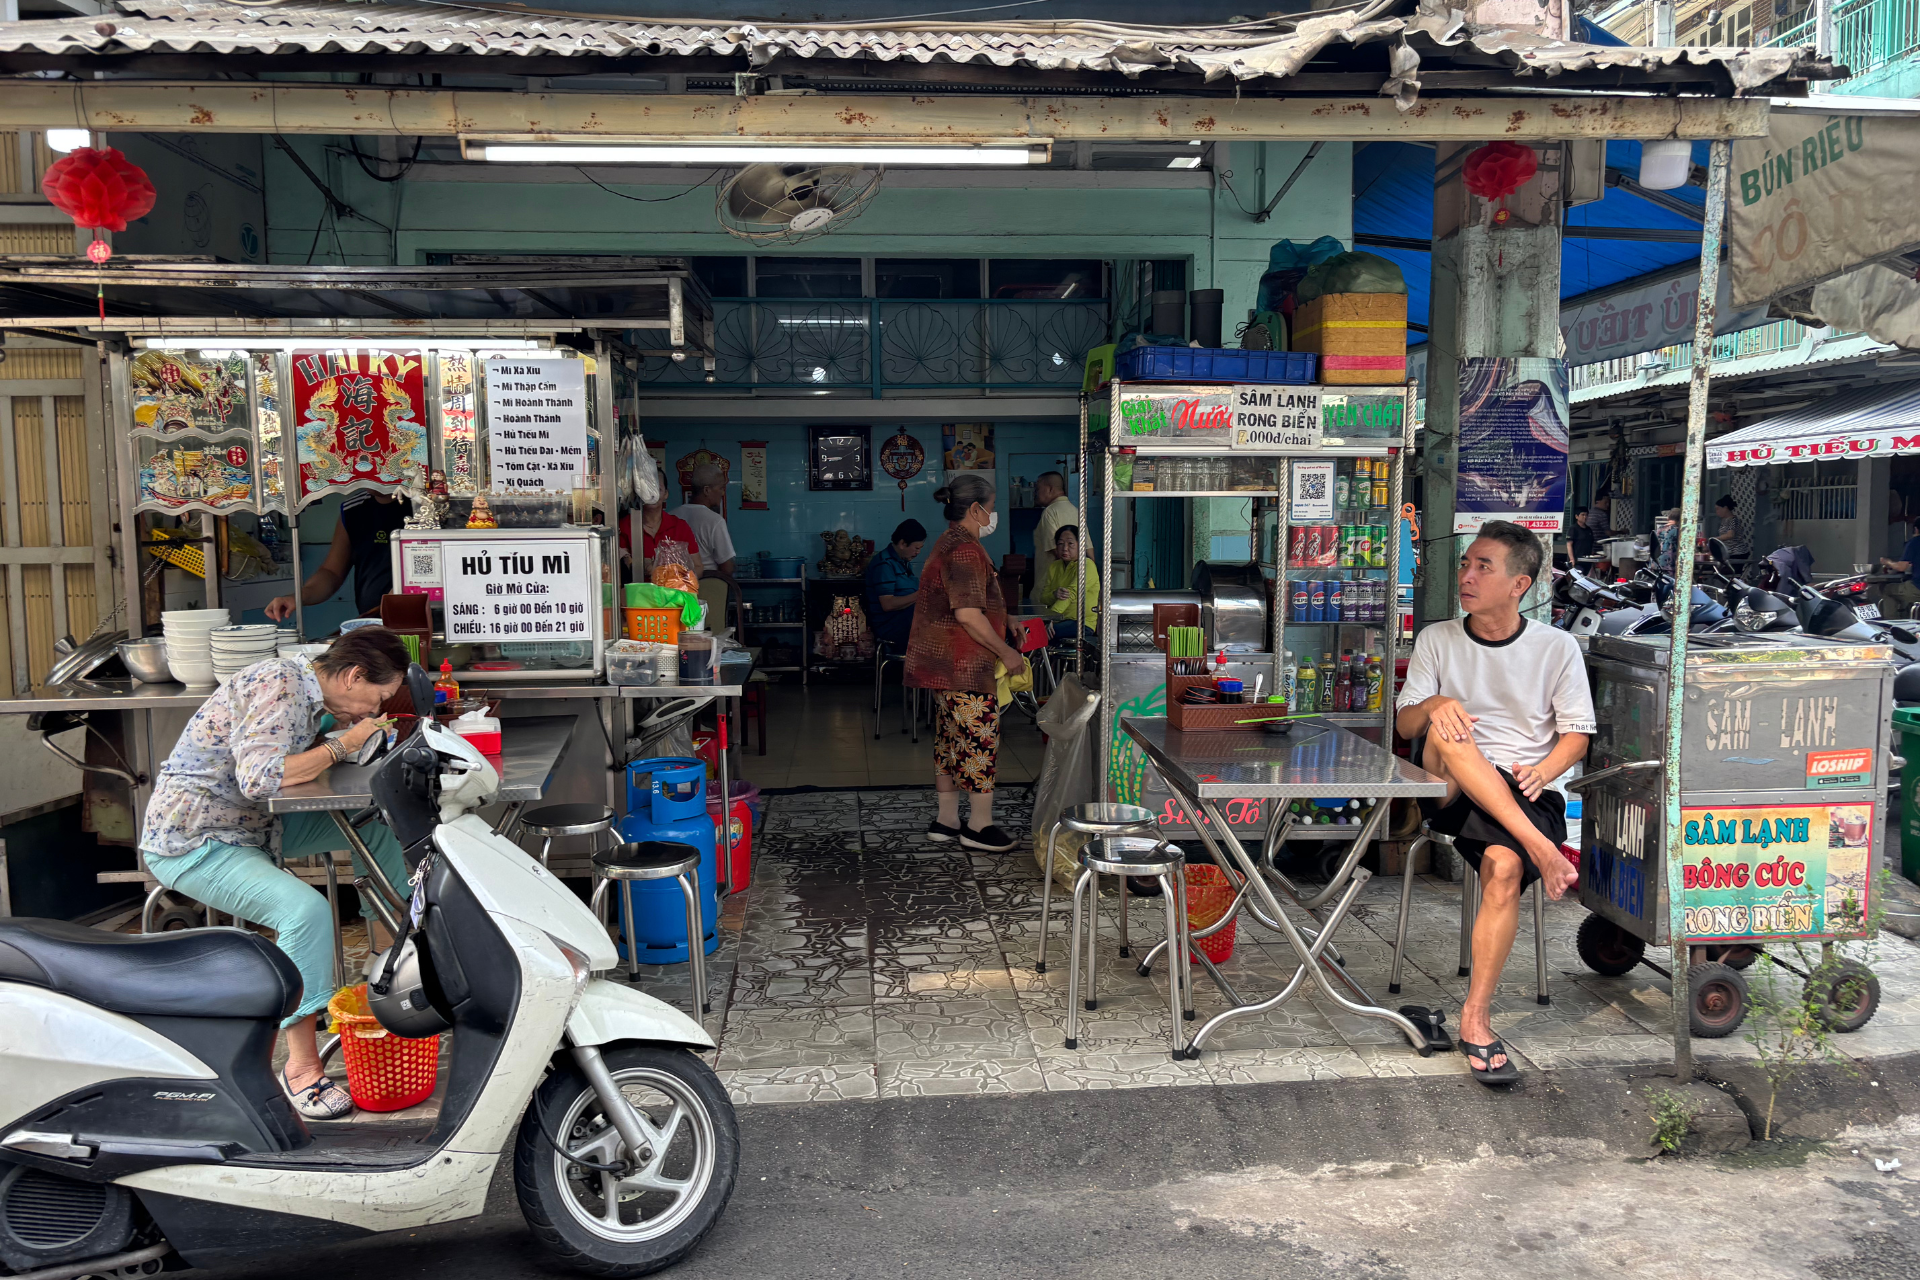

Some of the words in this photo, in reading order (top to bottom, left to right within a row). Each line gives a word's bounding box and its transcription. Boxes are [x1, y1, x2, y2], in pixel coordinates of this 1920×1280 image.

[1740, 149, 1793, 206] BÚN
[296, 348, 360, 386] HAI
[368, 348, 420, 383] KY
[1120, 395, 1152, 417] Giải
[1239, 390, 1272, 406] SÂM
[1277, 394, 1317, 410] LẠNH
[1362, 396, 1404, 428] CHẤT
[1128, 411, 1168, 436] Khát
[1237, 413, 1277, 428] RONG
[1282, 409, 1317, 429] BIỂN
[1726, 444, 1778, 462] HỦ
[1785, 436, 1881, 457] TIẾU
[462, 550, 492, 575] HỦ
[499, 552, 534, 574] TÍU
[542, 551, 570, 574] MÌ
[486, 583, 503, 594] Giờ
[506, 582, 522, 594] Mở
[526, 582, 550, 594] Cửa:
[452, 602, 478, 616] SÁNG
[494, 604, 500, 614] 6
[503, 603, 518, 616] giờ
[520, 603, 532, 614] 00
[534, 601, 552, 614] Đến
[555, 602, 566, 614] 10
[569, 602, 584, 615] giờ
[490, 622, 500, 634] 16
[504, 622, 518, 634] giờ
[521, 622, 532, 633] 00
[535, 620, 552, 632] Đến
[556, 622, 566, 632] 21
[570, 621, 584, 634] giờ
[1780, 697, 1838, 756] LẠNH
[1811, 758, 1864, 774] LOSHIP
[1226, 798, 1267, 824] Tố
[1616, 800, 1646, 860] LẠNH
[1684, 812, 1737, 845] SÂM
[1741, 818, 1810, 848] LẠNH
[1683, 857, 1750, 889] BÔNG
[1755, 855, 1805, 887] CÚC
[1684, 907, 1748, 933] RONG
[1751, 890, 1812, 932] BIỂN
